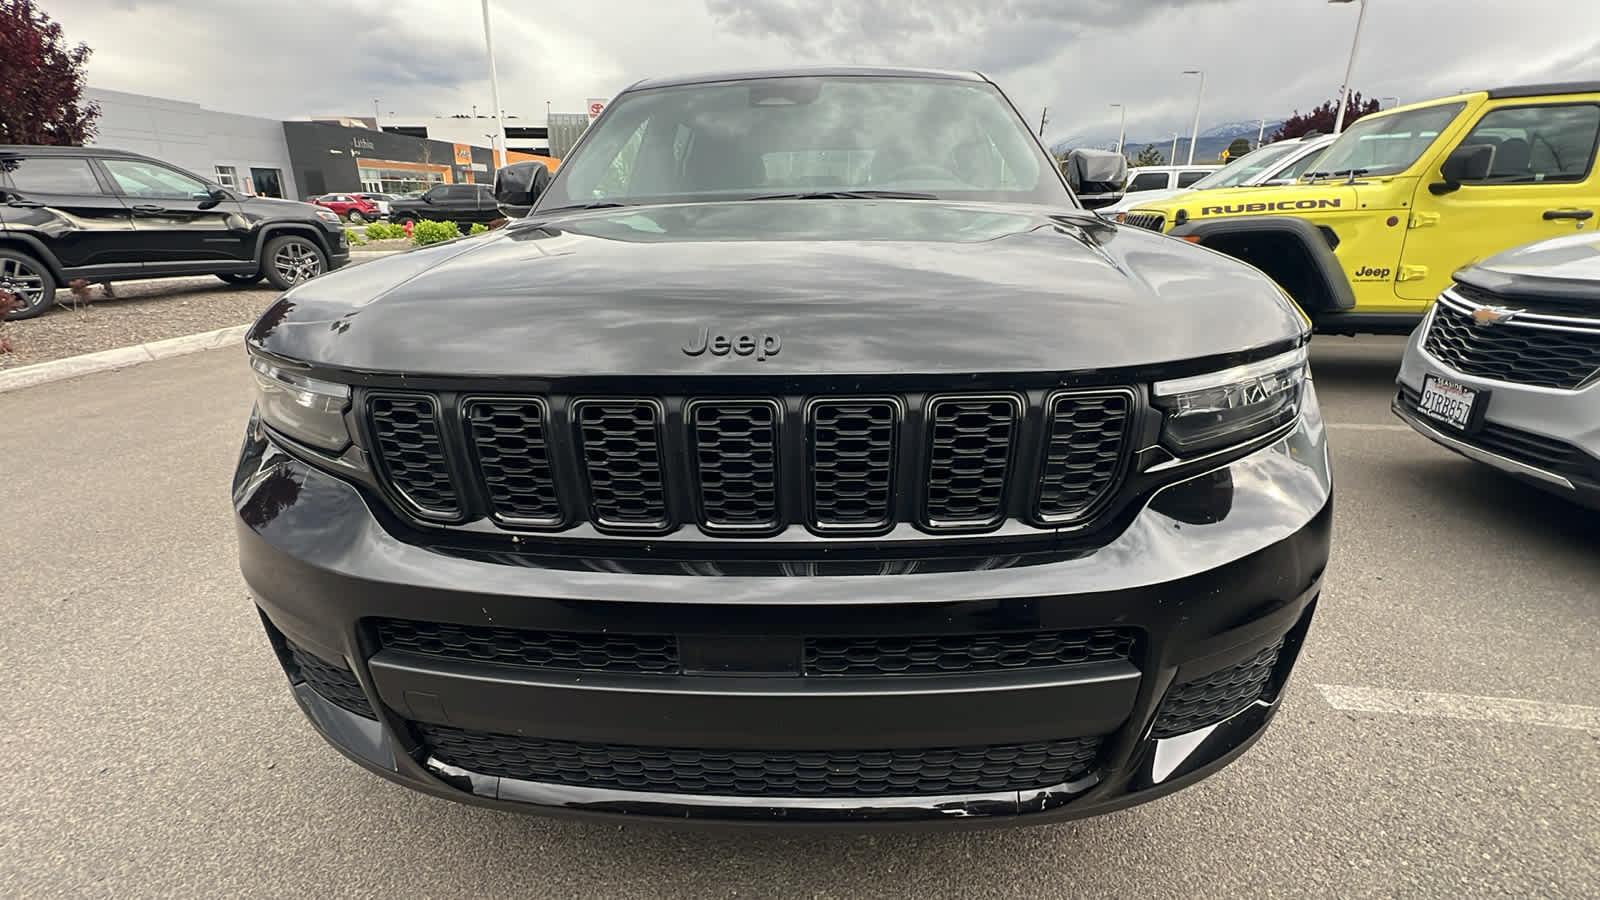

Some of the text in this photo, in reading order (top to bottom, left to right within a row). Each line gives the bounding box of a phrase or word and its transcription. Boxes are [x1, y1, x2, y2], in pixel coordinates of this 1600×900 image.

[1201, 198, 1341, 215] RUBICON
[1355, 266, 1390, 278] Jeep
[681, 327, 783, 361] Jeep
[1423, 390, 1471, 424] 9TRB857
